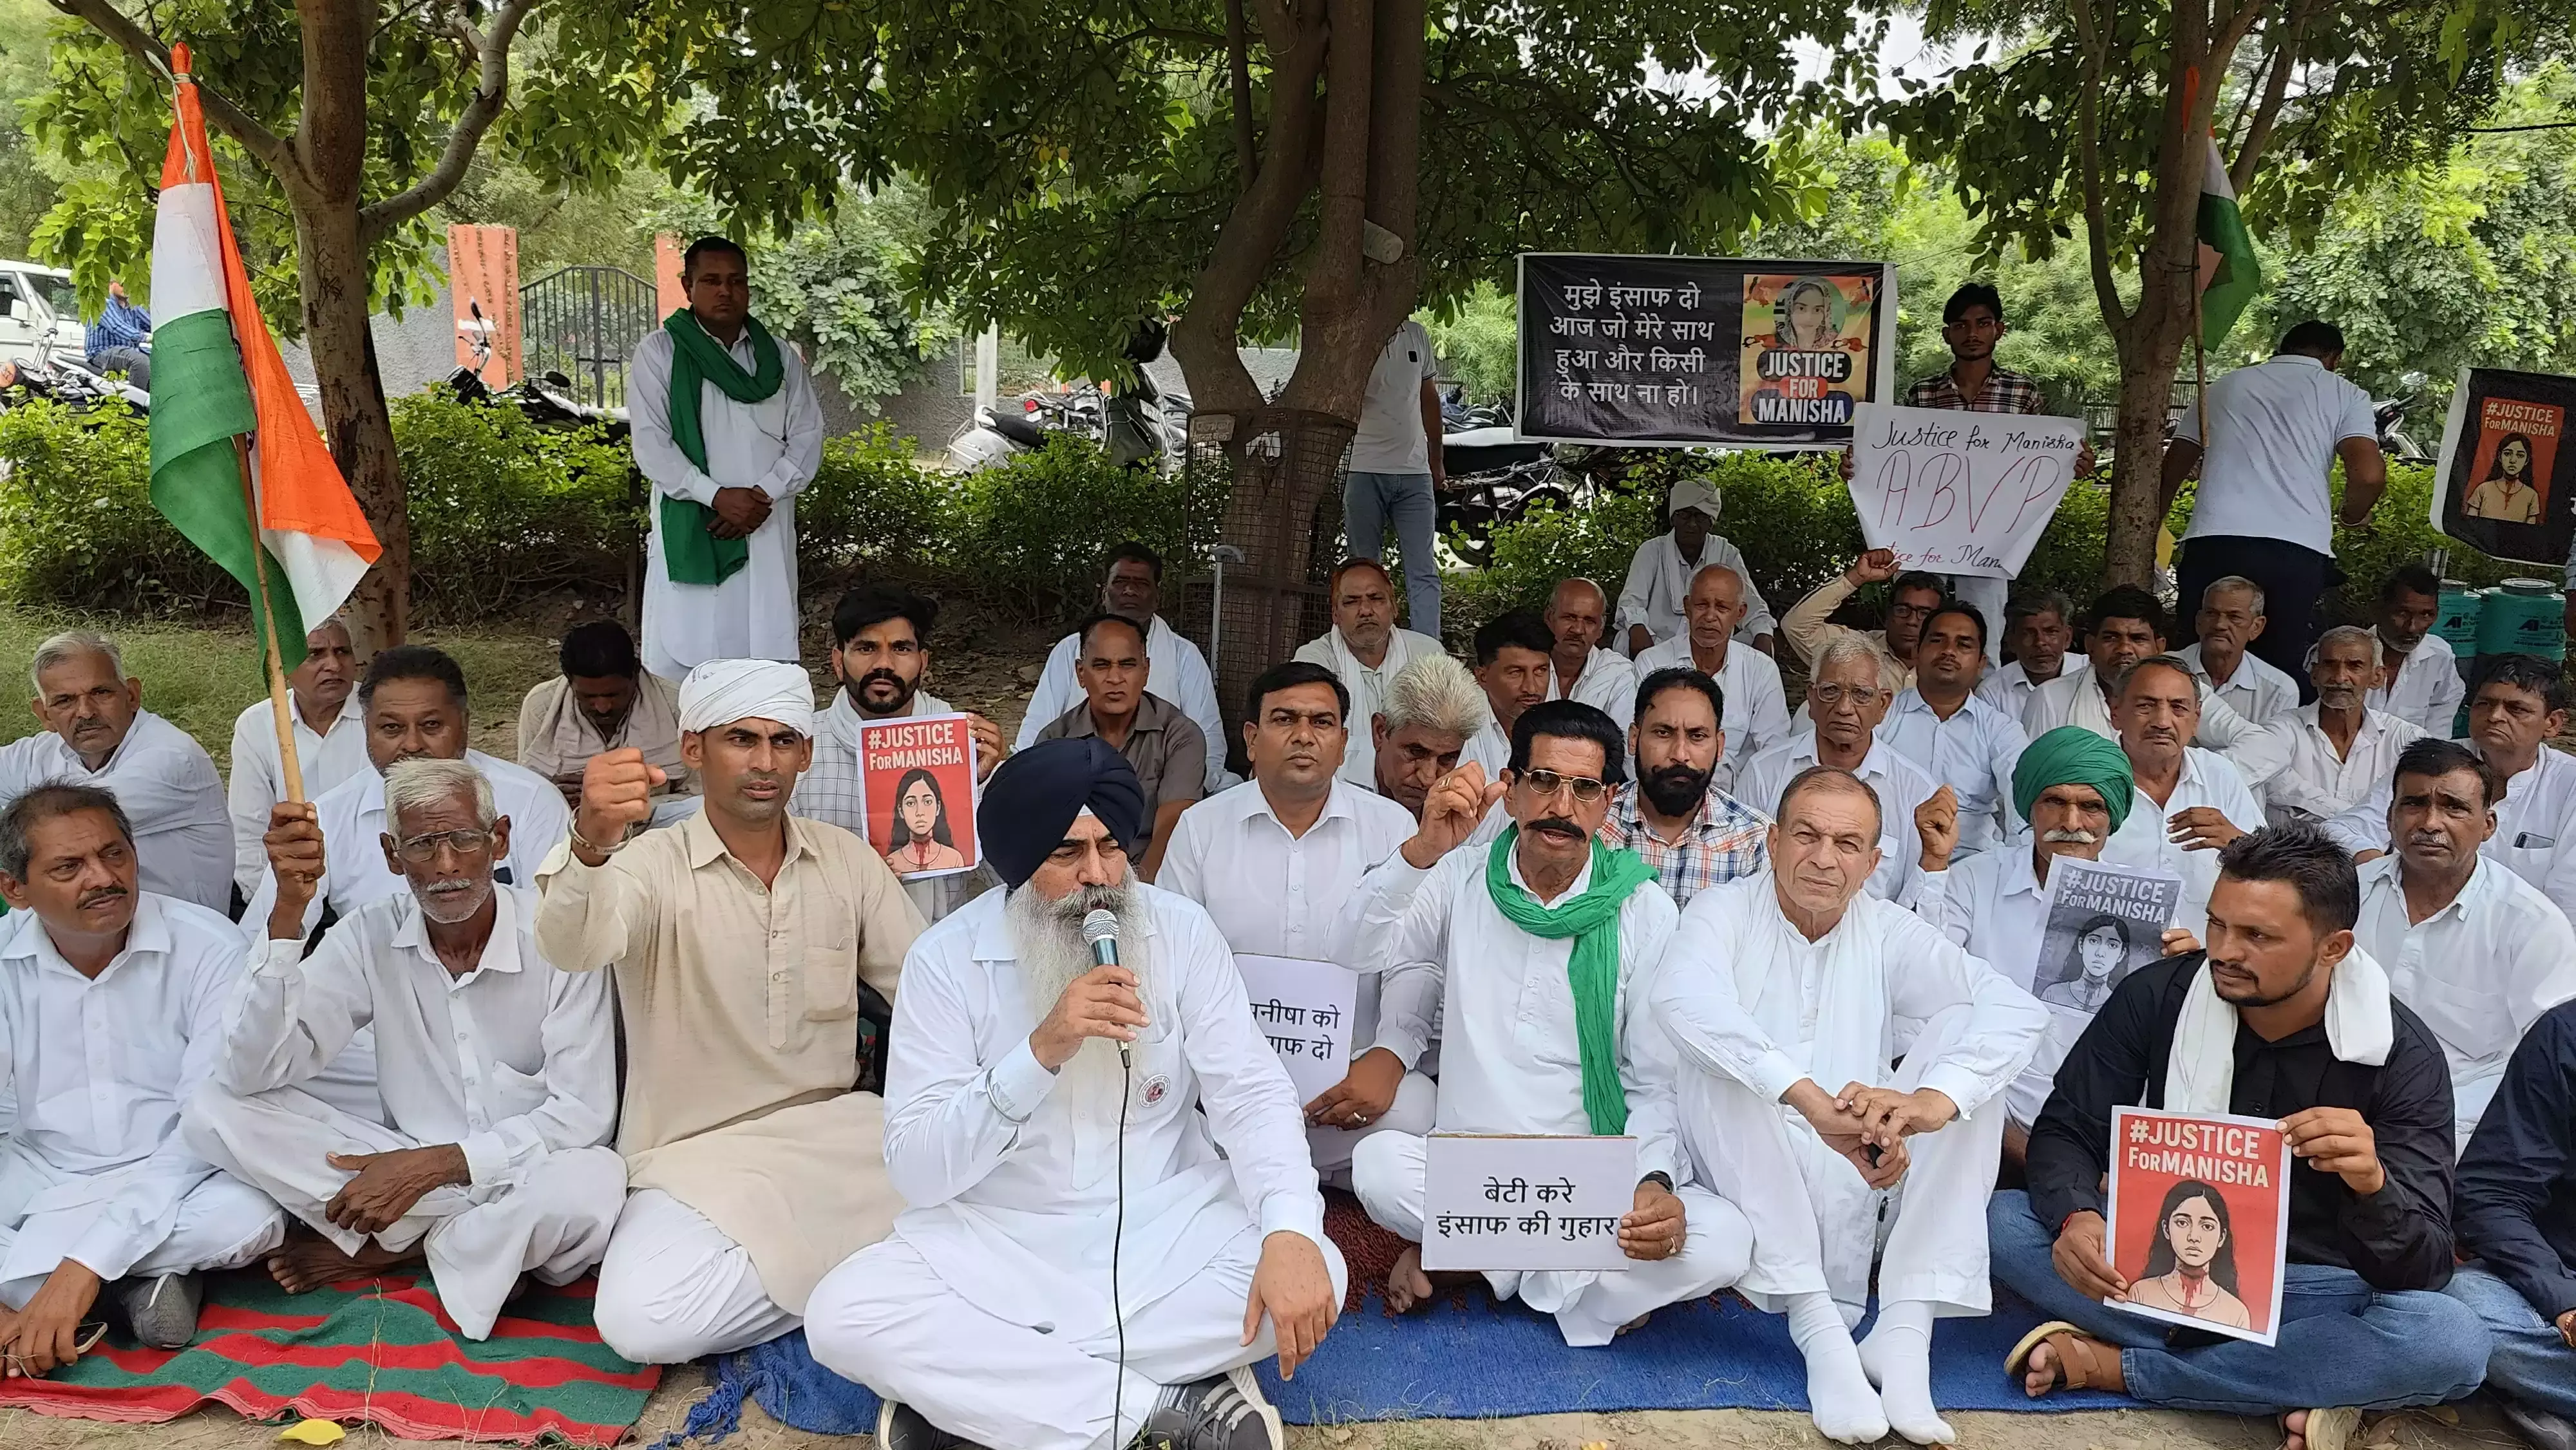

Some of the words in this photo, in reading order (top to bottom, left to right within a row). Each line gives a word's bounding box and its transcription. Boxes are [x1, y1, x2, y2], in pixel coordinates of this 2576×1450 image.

[1564, 278, 1603, 310] मुझे
[1608, 281, 1672, 310] इंसाफ
[1677, 281, 1701, 310] दो
[1549, 316, 1596, 337] आज
[1600, 312, 1629, 338] जो
[1634, 312, 1665, 340] मेरे
[1671, 321, 1715, 341] साथ
[1555, 349, 1598, 373] हुआ
[1605, 344, 1645, 372] और
[1649, 346, 1706, 373] किसी
[1765, 352, 1845, 377] JUSTICE
[1558, 374, 1582, 400] के
[1587, 382, 1631, 402] साथ
[1635, 384, 1660, 403] ना
[1789, 378, 1819, 398] FOR
[1758, 398, 1846, 423] MANISHA
[2486, 402, 2553, 423] #JUSTICE
[1872, 419, 1958, 449] Justice
[1965, 425, 1990, 451] for
[2001, 431, 2074, 453] Manisha
[1877, 449, 2060, 533] ABVP
[1886, 541, 1913, 563] tice
[1913, 547, 1945, 567] for
[868, 723, 954, 749] #JUSTICE
[2066, 869, 2165, 903] #JUSTICE
[1312, 1004, 1341, 1029] को
[1311, 1034, 1334, 1060] दो
[2130, 1119, 2260, 1160] #JUSTICE
[1483, 1176, 1529, 1203] बेटी
[1535, 1176, 1576, 1203] करे
[1436, 1210, 1510, 1238] इंसाफ
[1517, 1210, 1551, 1235] की
[1558, 1217, 1618, 1241] गुहार
